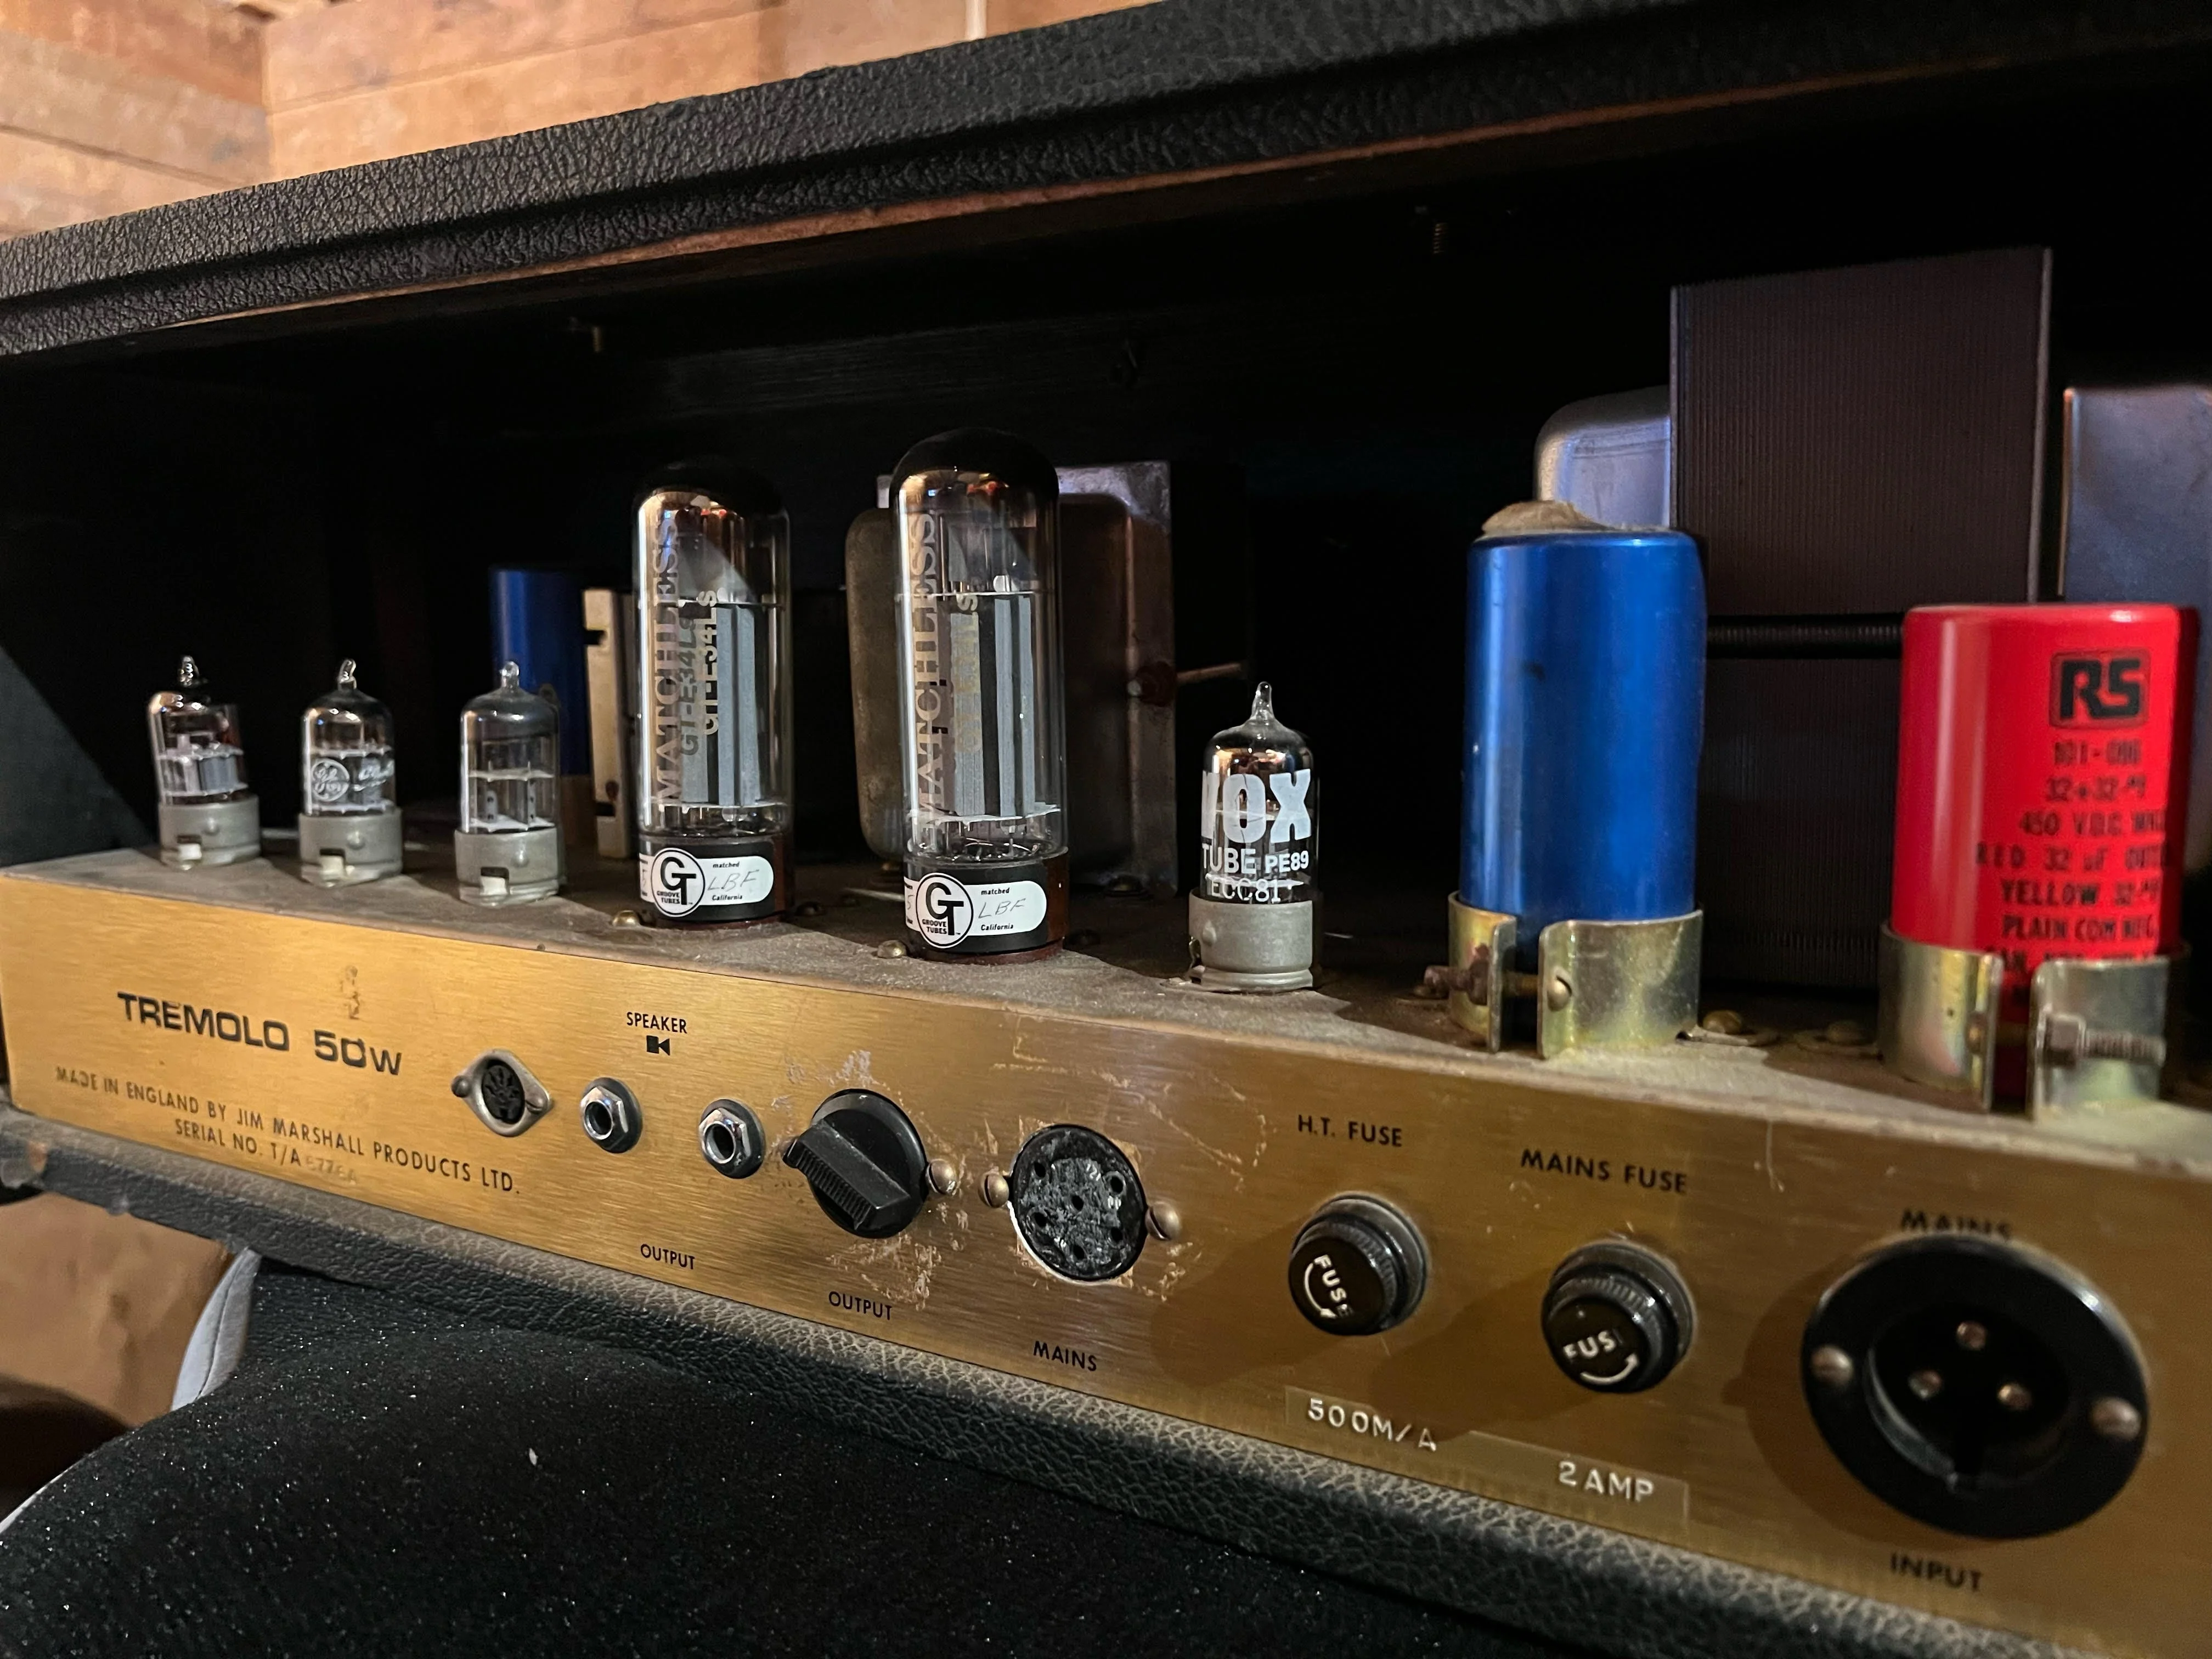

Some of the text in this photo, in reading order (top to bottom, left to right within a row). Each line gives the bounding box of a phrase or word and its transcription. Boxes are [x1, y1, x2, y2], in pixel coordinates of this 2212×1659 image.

[2059, 659, 2141, 720] RS
[1203, 843, 1310, 874] TUBE PE89
[660, 856, 697, 905] GT
[981, 887, 1010, 895] matched
[1211, 878, 1281, 903] ECC81
[2000, 877, 2101, 906] YELLOW
[922, 918, 947, 927] GROOVE
[926, 882, 964, 936] GT
[927, 926, 947, 934] TUBES
[981, 922, 1014, 931] California
[116, 991, 290, 1052] TREMOLO
[626, 1011, 687, 1034] SPEAKER
[57, 1066, 520, 1194] MADE IN ENGLAND BY JIM MARSHALL PRODUCTS LTD.
[175, 1118, 225, 1146] SERIAL
[233, 1133, 263, 1156] NO.
[1297, 1114, 1403, 1148] H.T. FUSE
[1520, 1148, 1687, 1194] MAINS FUSE
[1900, 1210, 2012, 1240] MAINS
[640, 1243, 695, 1270] OUTPUT
[828, 1290, 892, 1321] OUTPUT
[1032, 1340, 1097, 1373] MAINS
[1891, 1551, 1983, 1592] INPUT
